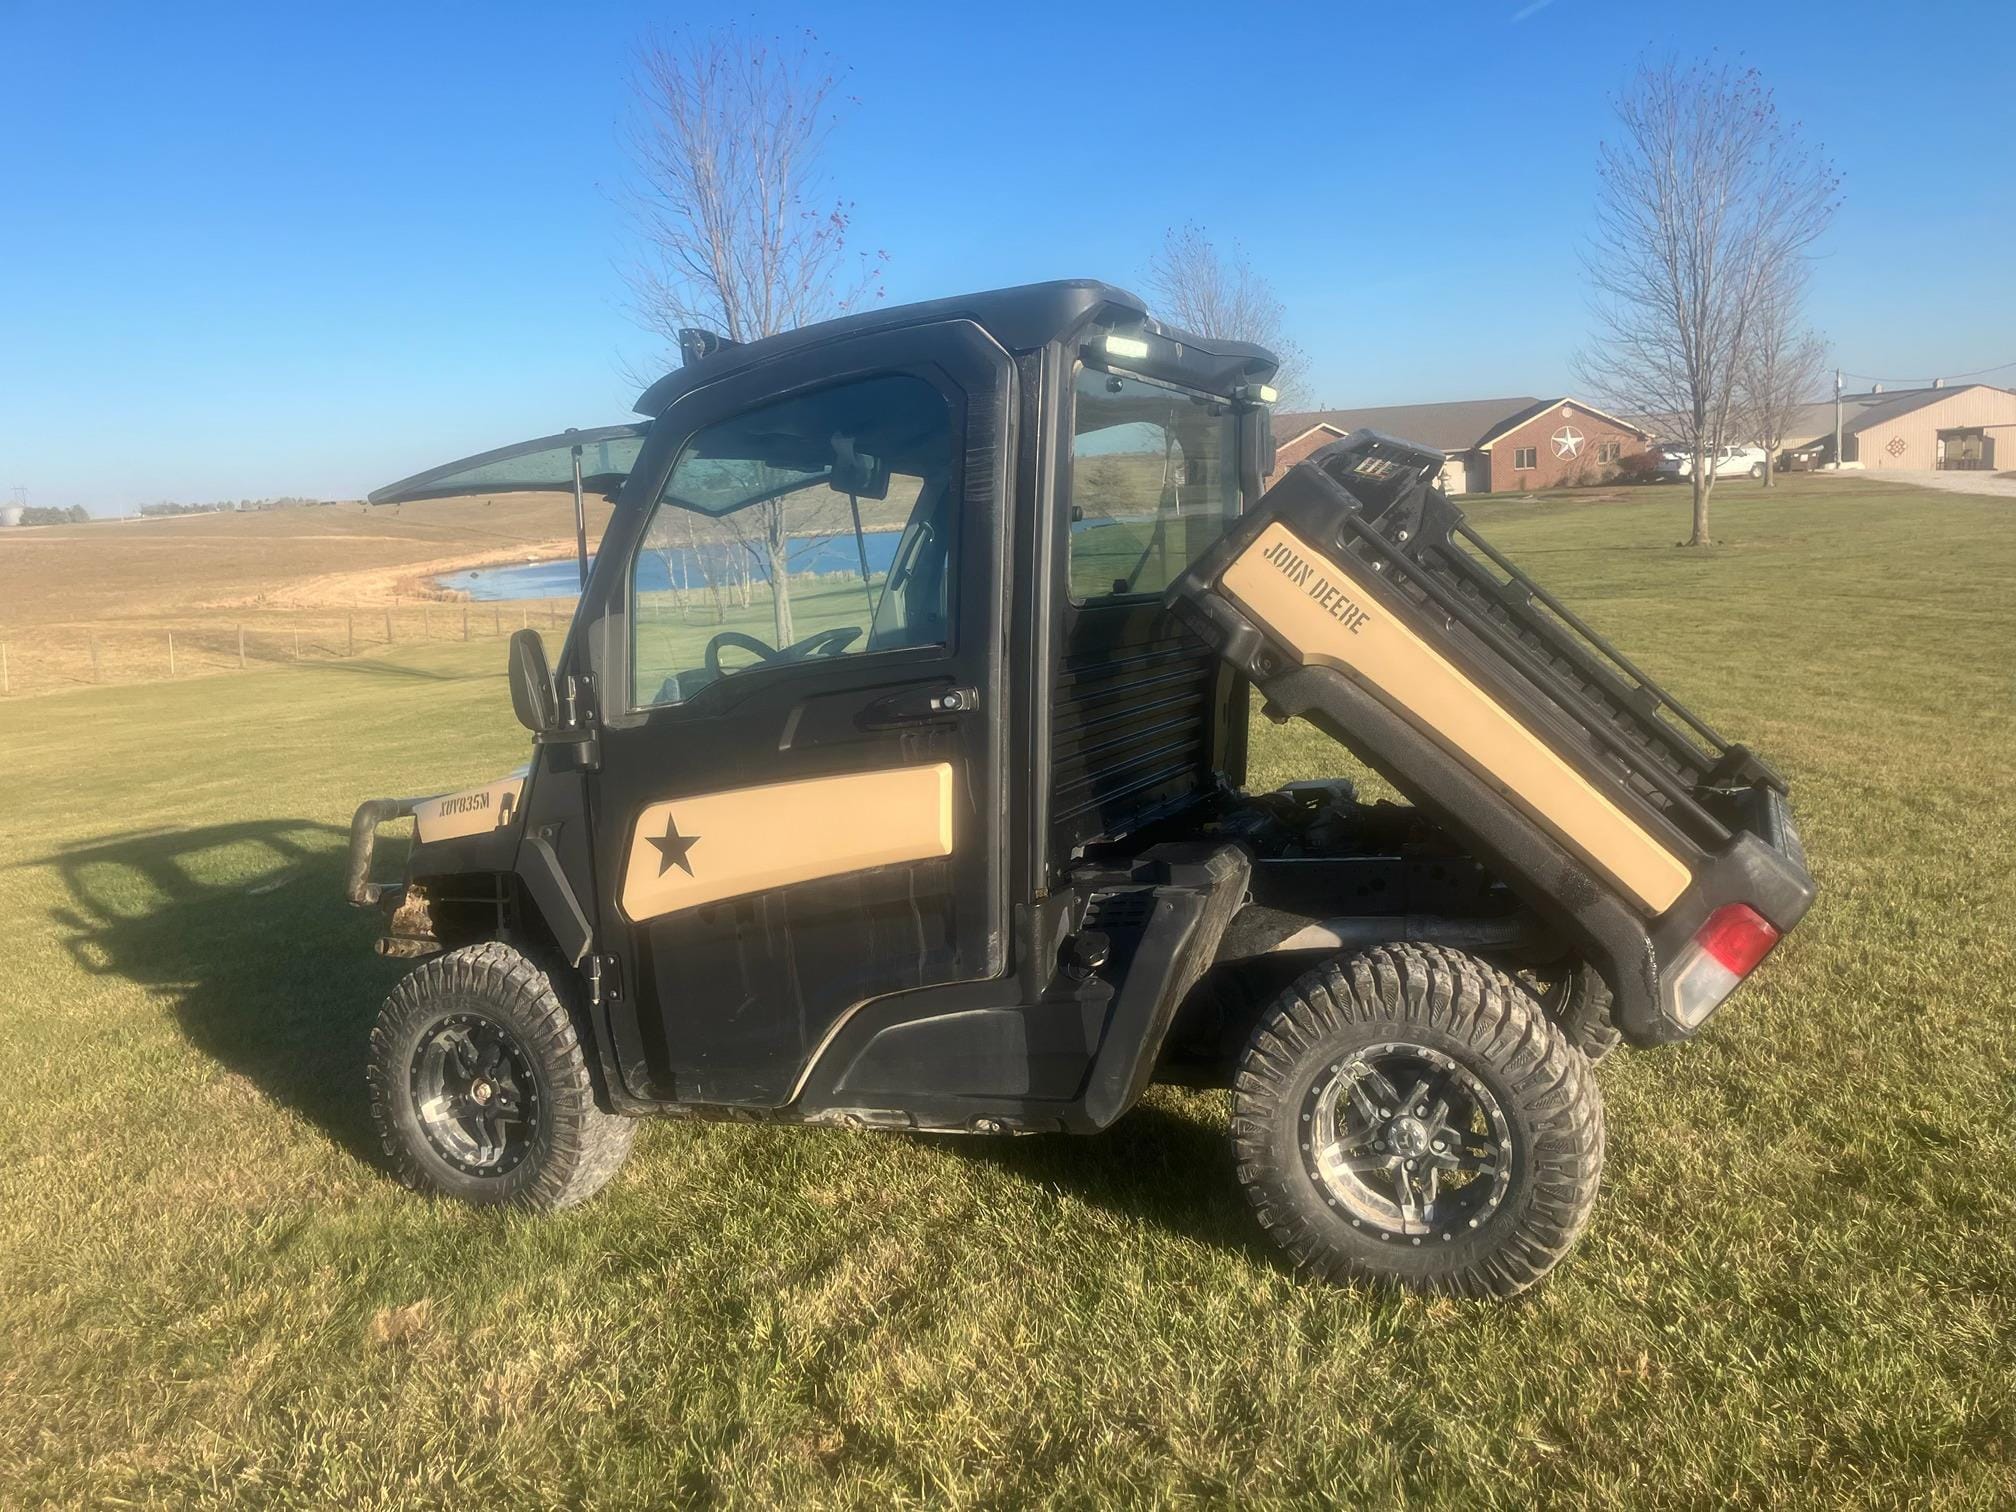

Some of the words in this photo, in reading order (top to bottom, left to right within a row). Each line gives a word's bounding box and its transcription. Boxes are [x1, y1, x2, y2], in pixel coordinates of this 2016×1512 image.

[1263, 542, 1315, 588] JOHN
[1308, 578, 1371, 635] DEERE
[439, 791, 490, 818] XUV835M
